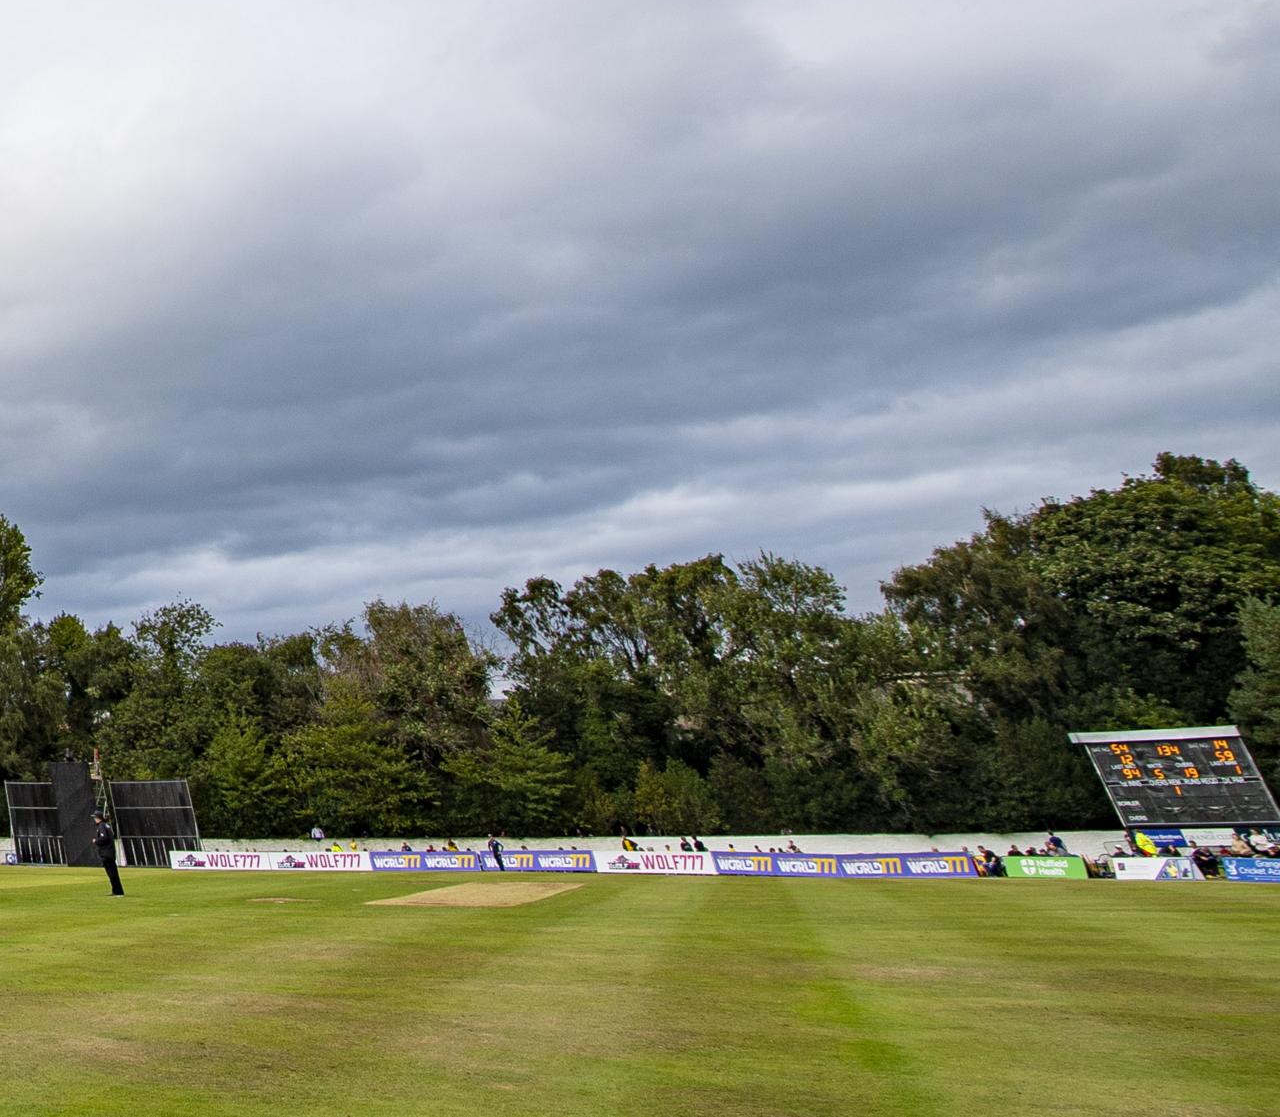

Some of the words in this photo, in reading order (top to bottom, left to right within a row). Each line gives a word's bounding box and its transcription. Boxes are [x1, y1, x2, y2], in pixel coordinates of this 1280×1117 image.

[1110, 743, 1130, 754] 54
[1156, 745, 1181, 756] 134
[1213, 739, 1229, 750] 14
[1120, 754, 1134, 765] 12
[1215, 750, 1235, 762] 59
[1122, 768, 1142, 779] 94
[1153, 768, 1166, 780] 5
[1184, 767, 1200, 779] 19
[1234, 765, 1243, 775] 1
[1174, 785, 1183, 796] 1
[206, 854, 261, 869] WOLF777
[305, 854, 361, 868] WOLF777
[373, 855, 421, 869] WORLD777
[425, 855, 475, 869] WORLD777
[538, 854, 590, 869] WORLD777
[640, 855, 704, 871] WOLF777
[716, 856, 772, 872] WORLD777
[777, 858, 837, 874] WORLD777
[842, 858, 902, 875] WORLD777
[906, 856, 970, 873] WORLD777
[1036, 859, 1069, 868] Nuffield
[1038, 867, 1066, 876] Health
